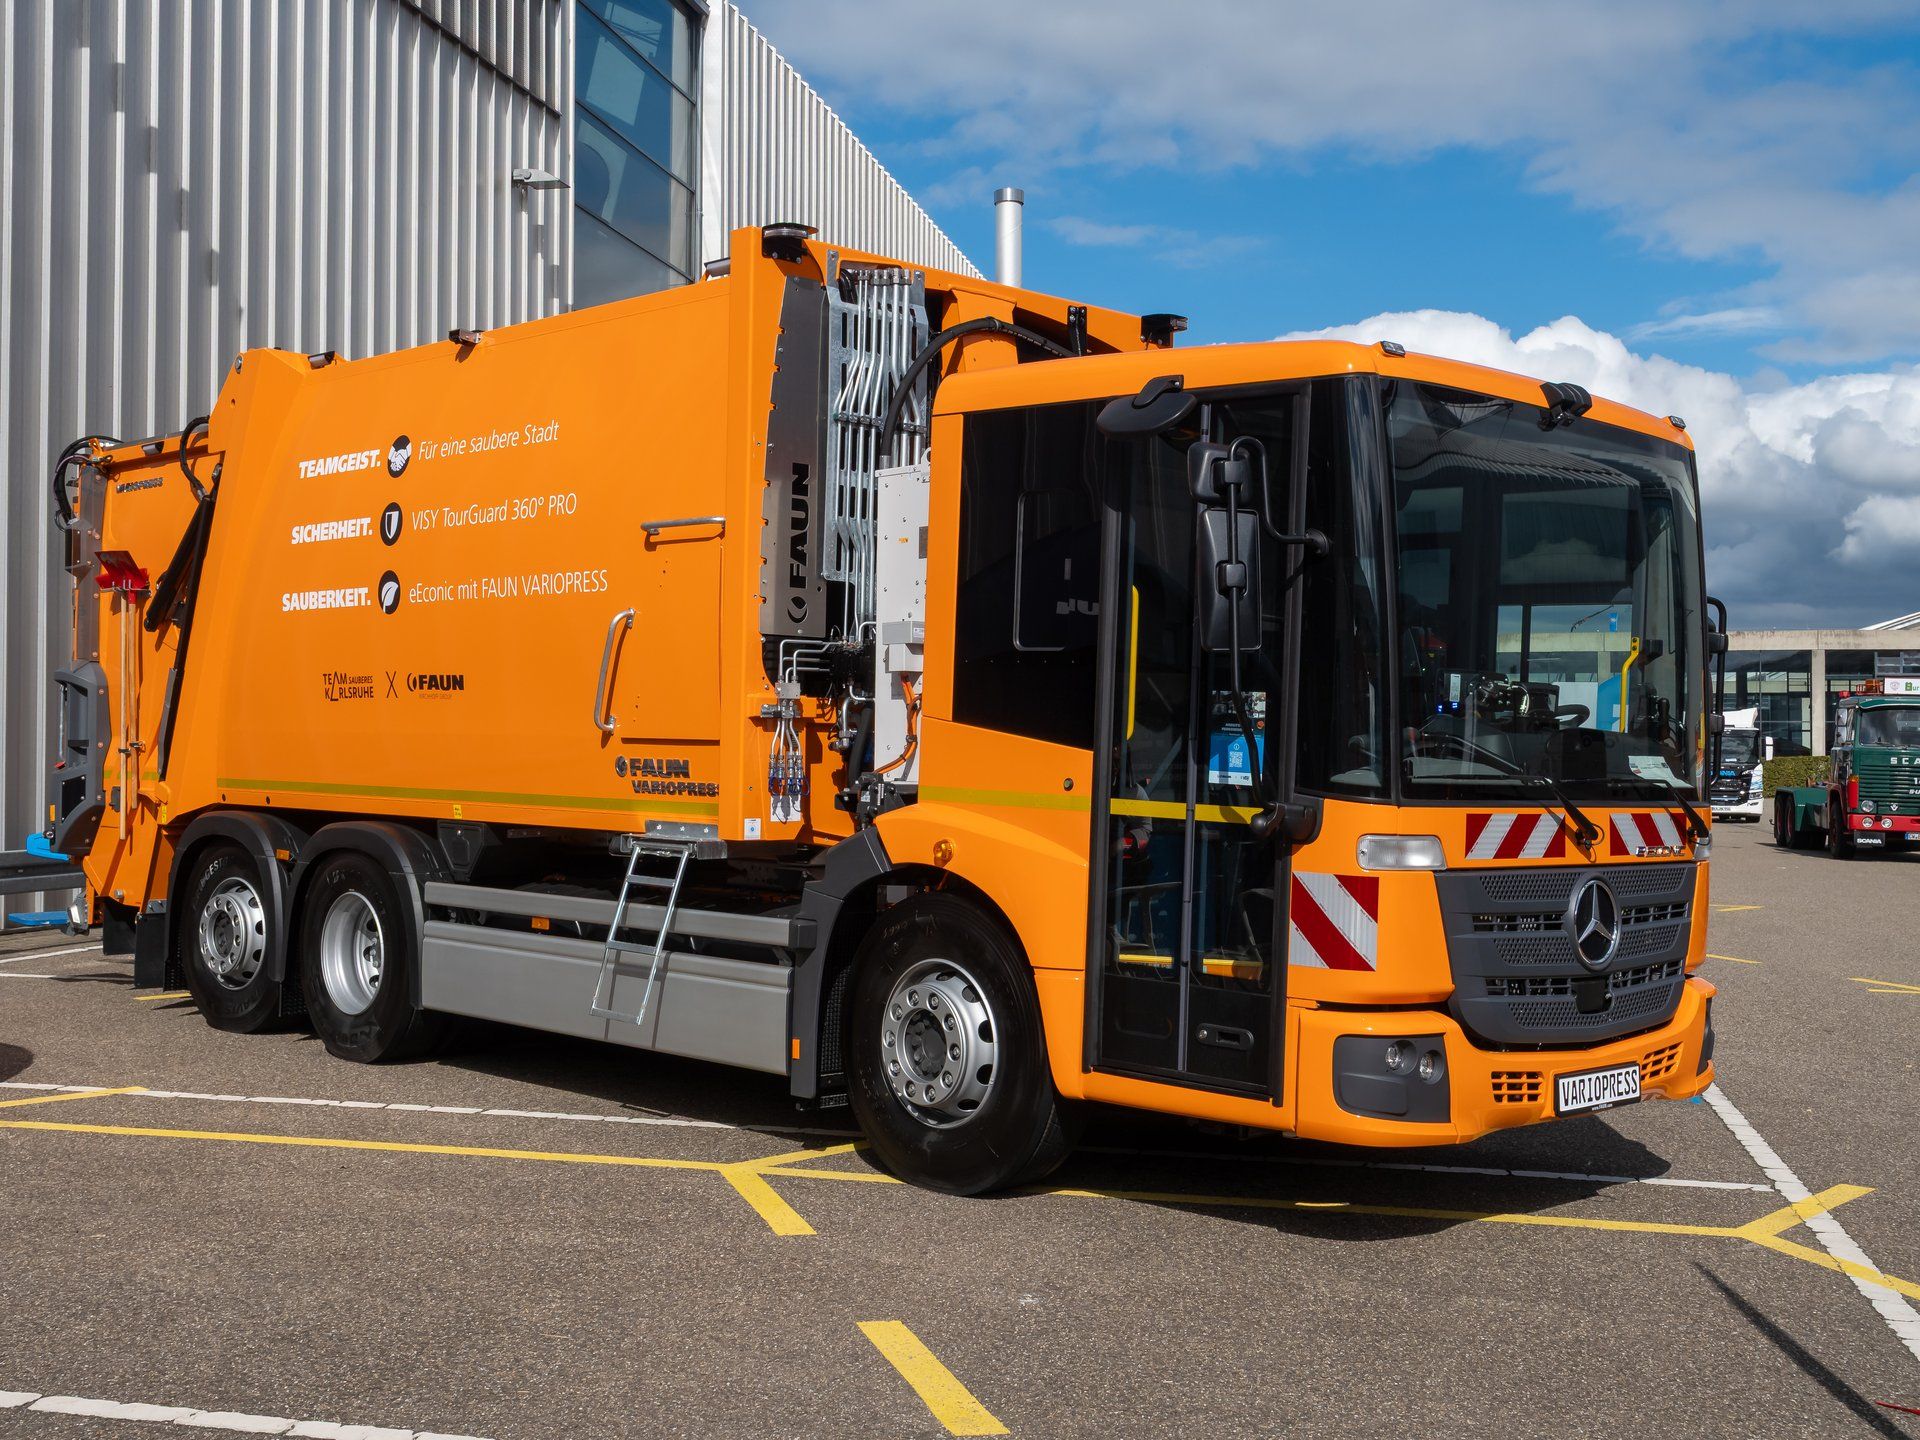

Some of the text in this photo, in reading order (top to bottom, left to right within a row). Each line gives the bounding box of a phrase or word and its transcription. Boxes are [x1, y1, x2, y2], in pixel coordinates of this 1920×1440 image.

[299, 420, 559, 479] TEAMGEIST. Für eine saubere Stadt
[291, 492, 577, 545] SICHERHEIT. VISY TourGuard 360° PRO
[789, 462, 810, 589] FAUN
[282, 569, 608, 612] SAUBERKEIT. eEconic mit FAUN VARIOPRESS
[322, 671, 373, 685] TEAM SAUBERES
[418, 674, 465, 691] FAUN
[324, 686, 374, 701] KARLSRUHE
[629, 758, 690, 778] FAUN
[632, 780, 719, 797] VARIOPRES
[1562, 1069, 1638, 1107] VARIOPRESS
